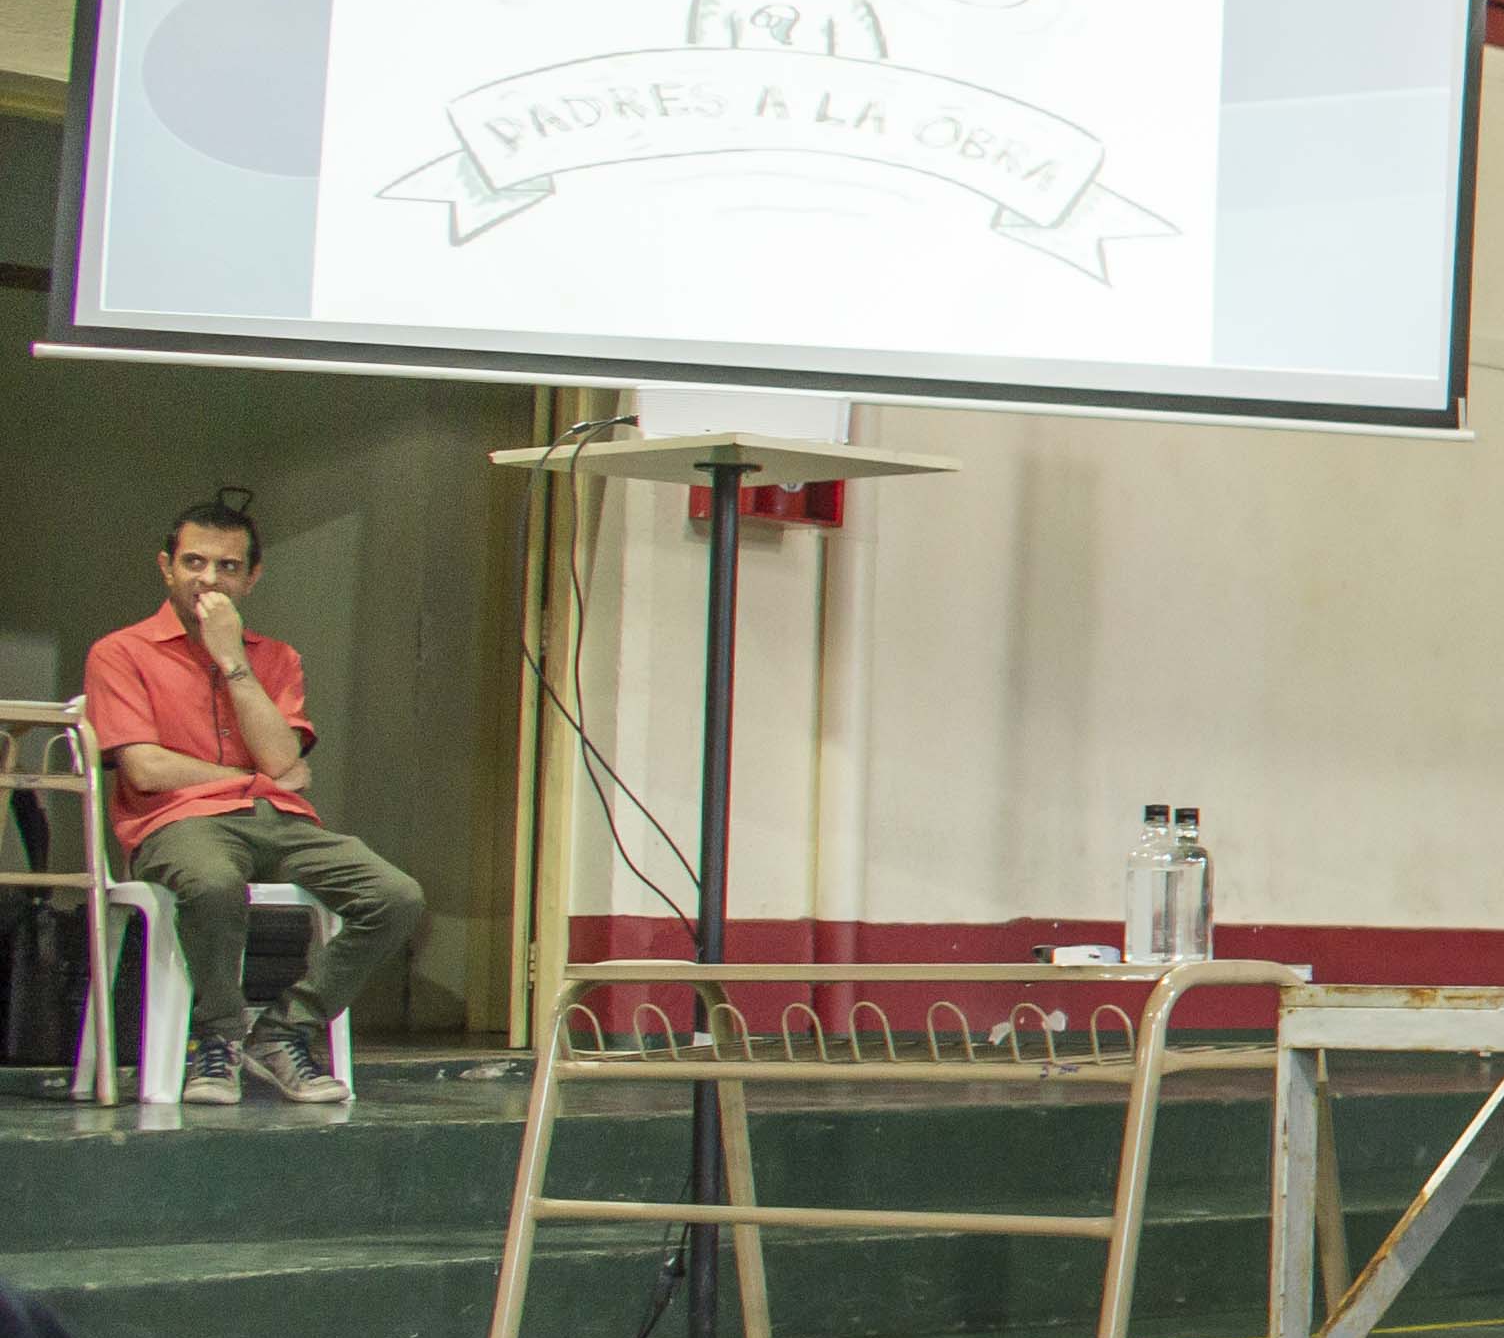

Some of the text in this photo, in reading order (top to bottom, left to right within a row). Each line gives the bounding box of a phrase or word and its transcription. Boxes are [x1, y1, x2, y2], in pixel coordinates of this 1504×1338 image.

[484, 82, 1057, 189] PADRES A LA OBRA
